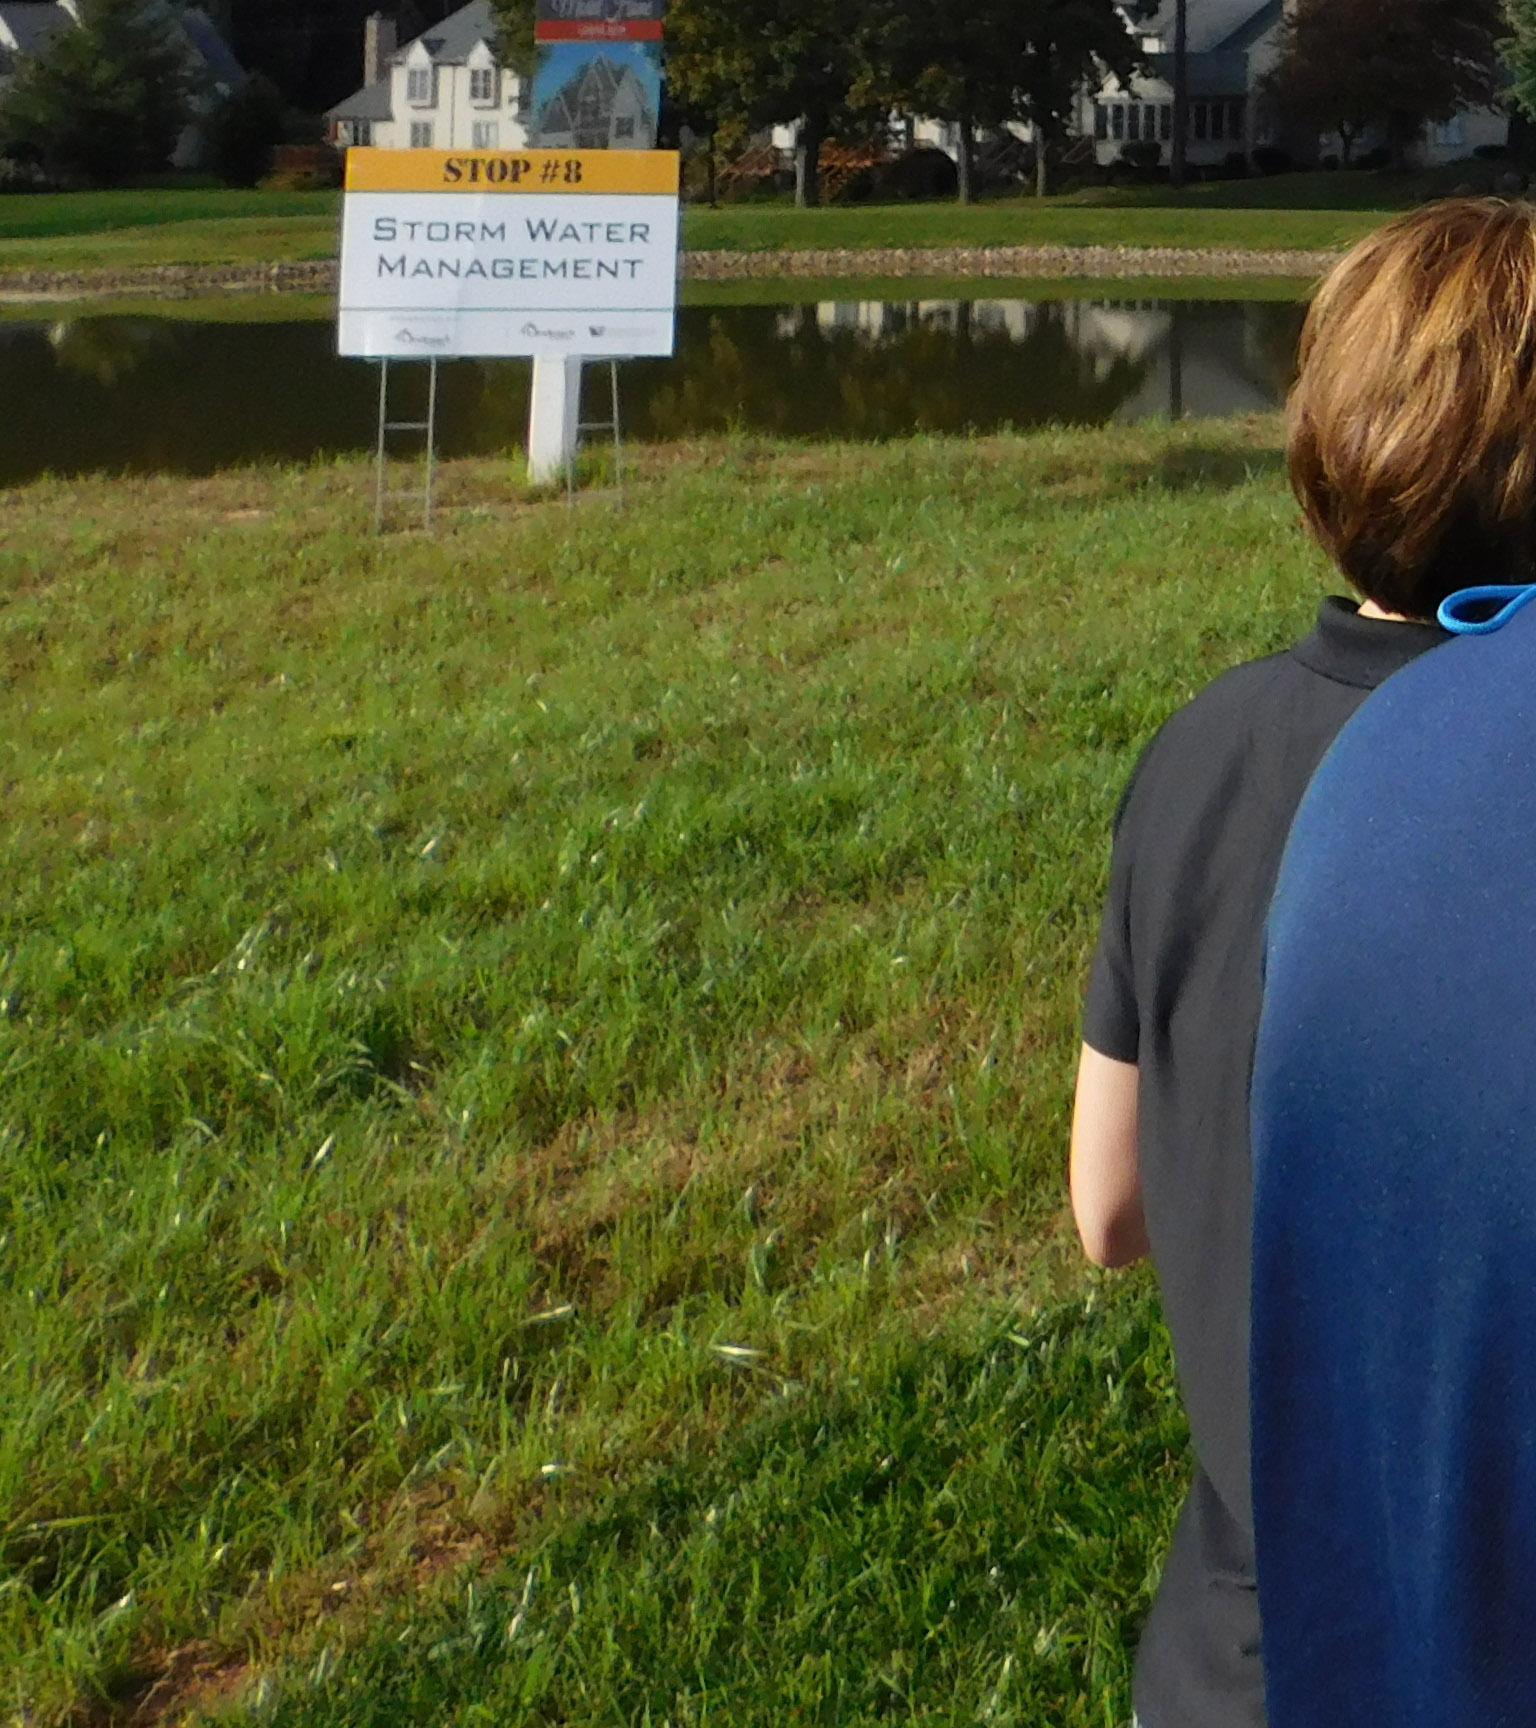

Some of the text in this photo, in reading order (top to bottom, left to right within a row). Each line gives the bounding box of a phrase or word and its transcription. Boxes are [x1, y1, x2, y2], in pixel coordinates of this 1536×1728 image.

[443, 157, 583, 184] STOP #8
[373, 217, 651, 243] STORM WATER
[377, 254, 645, 280] MANAGEMENT
